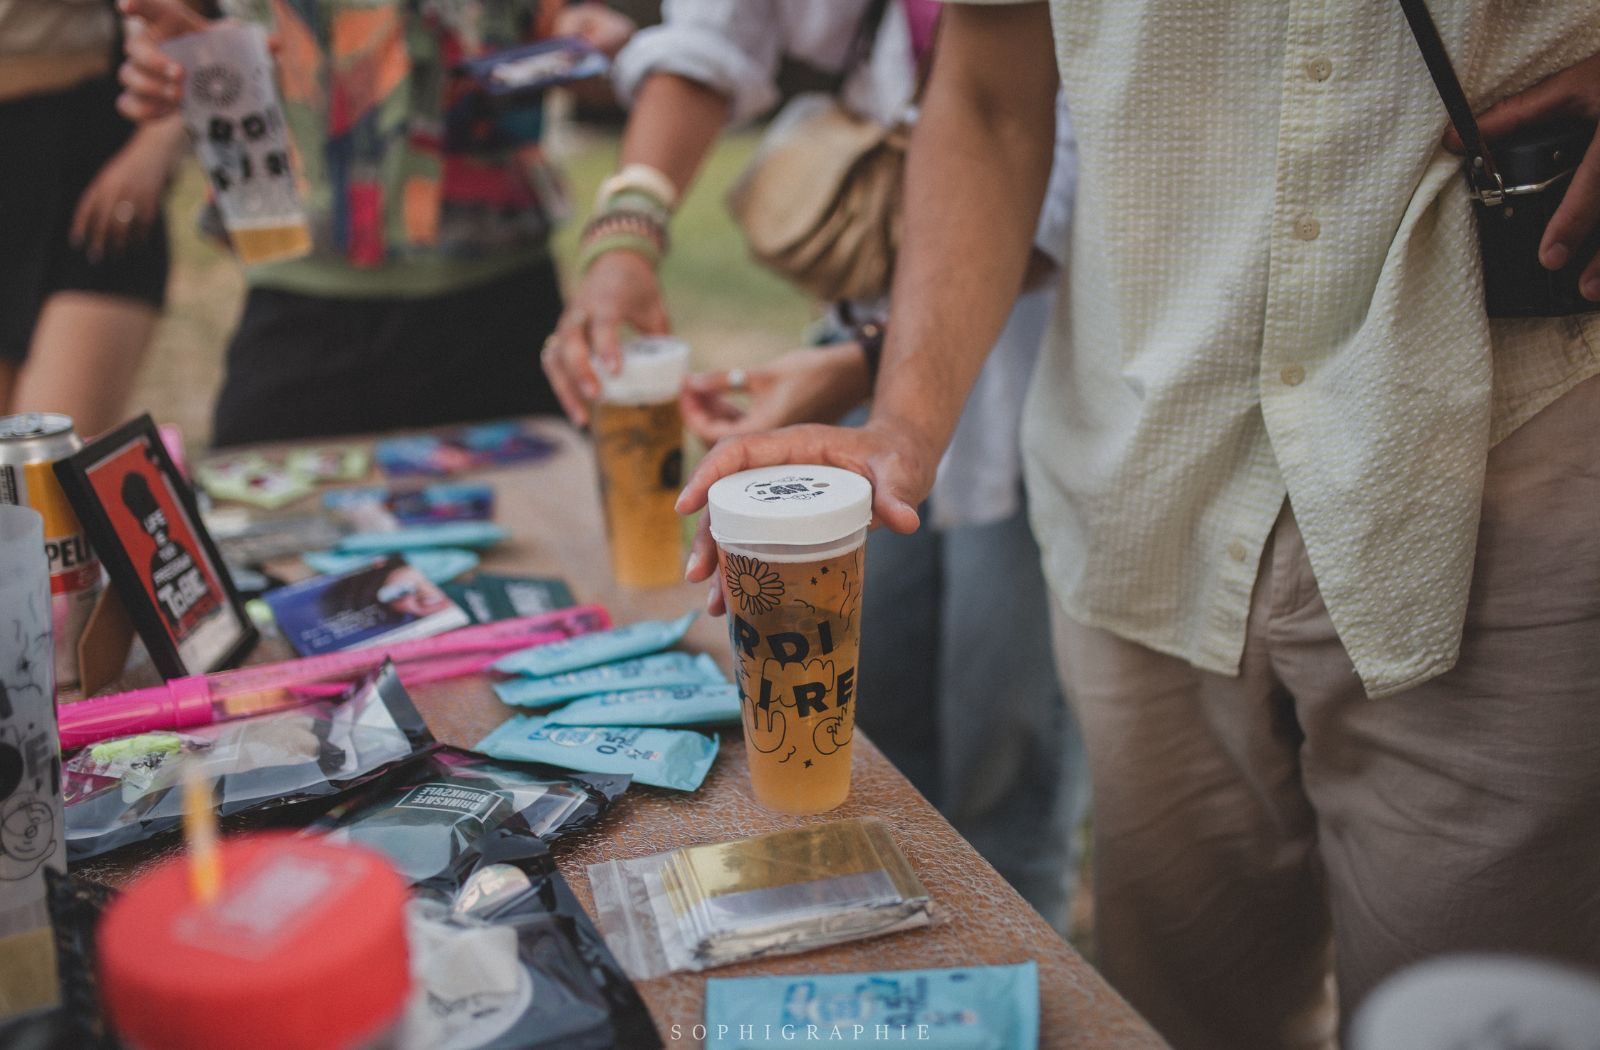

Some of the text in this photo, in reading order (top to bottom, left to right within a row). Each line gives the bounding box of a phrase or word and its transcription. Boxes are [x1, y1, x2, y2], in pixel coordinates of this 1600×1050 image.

[729, 613, 833, 663] RDI
[735, 666, 855, 718] IRE
[411, 794, 481, 811] DRINKSAFE
